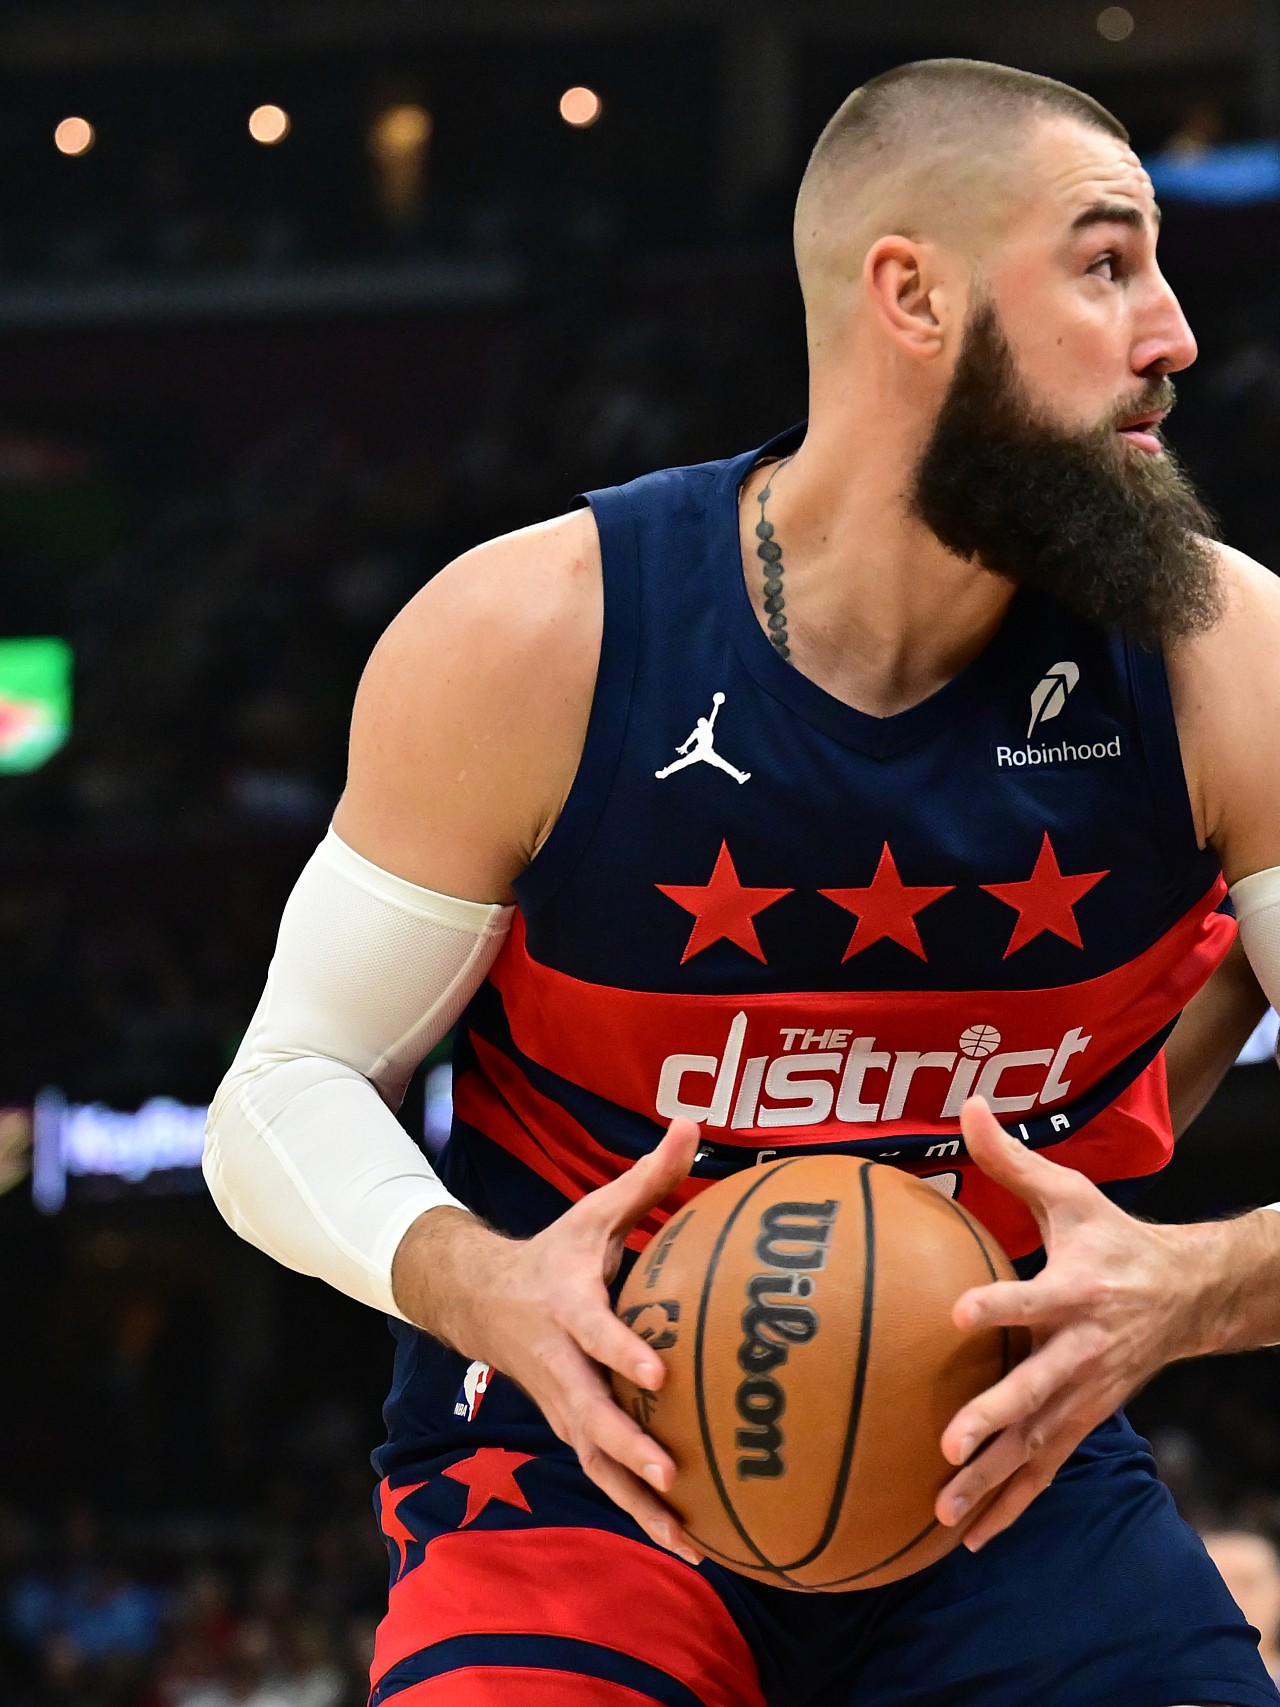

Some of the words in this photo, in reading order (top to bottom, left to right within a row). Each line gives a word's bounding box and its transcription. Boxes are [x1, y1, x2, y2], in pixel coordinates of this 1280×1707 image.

[996, 735, 1121, 767] Robinhood
[655, 1010, 1092, 1130] district
[779, 1028, 853, 1050] THE
[734, 1199, 840, 1482] Wilson
